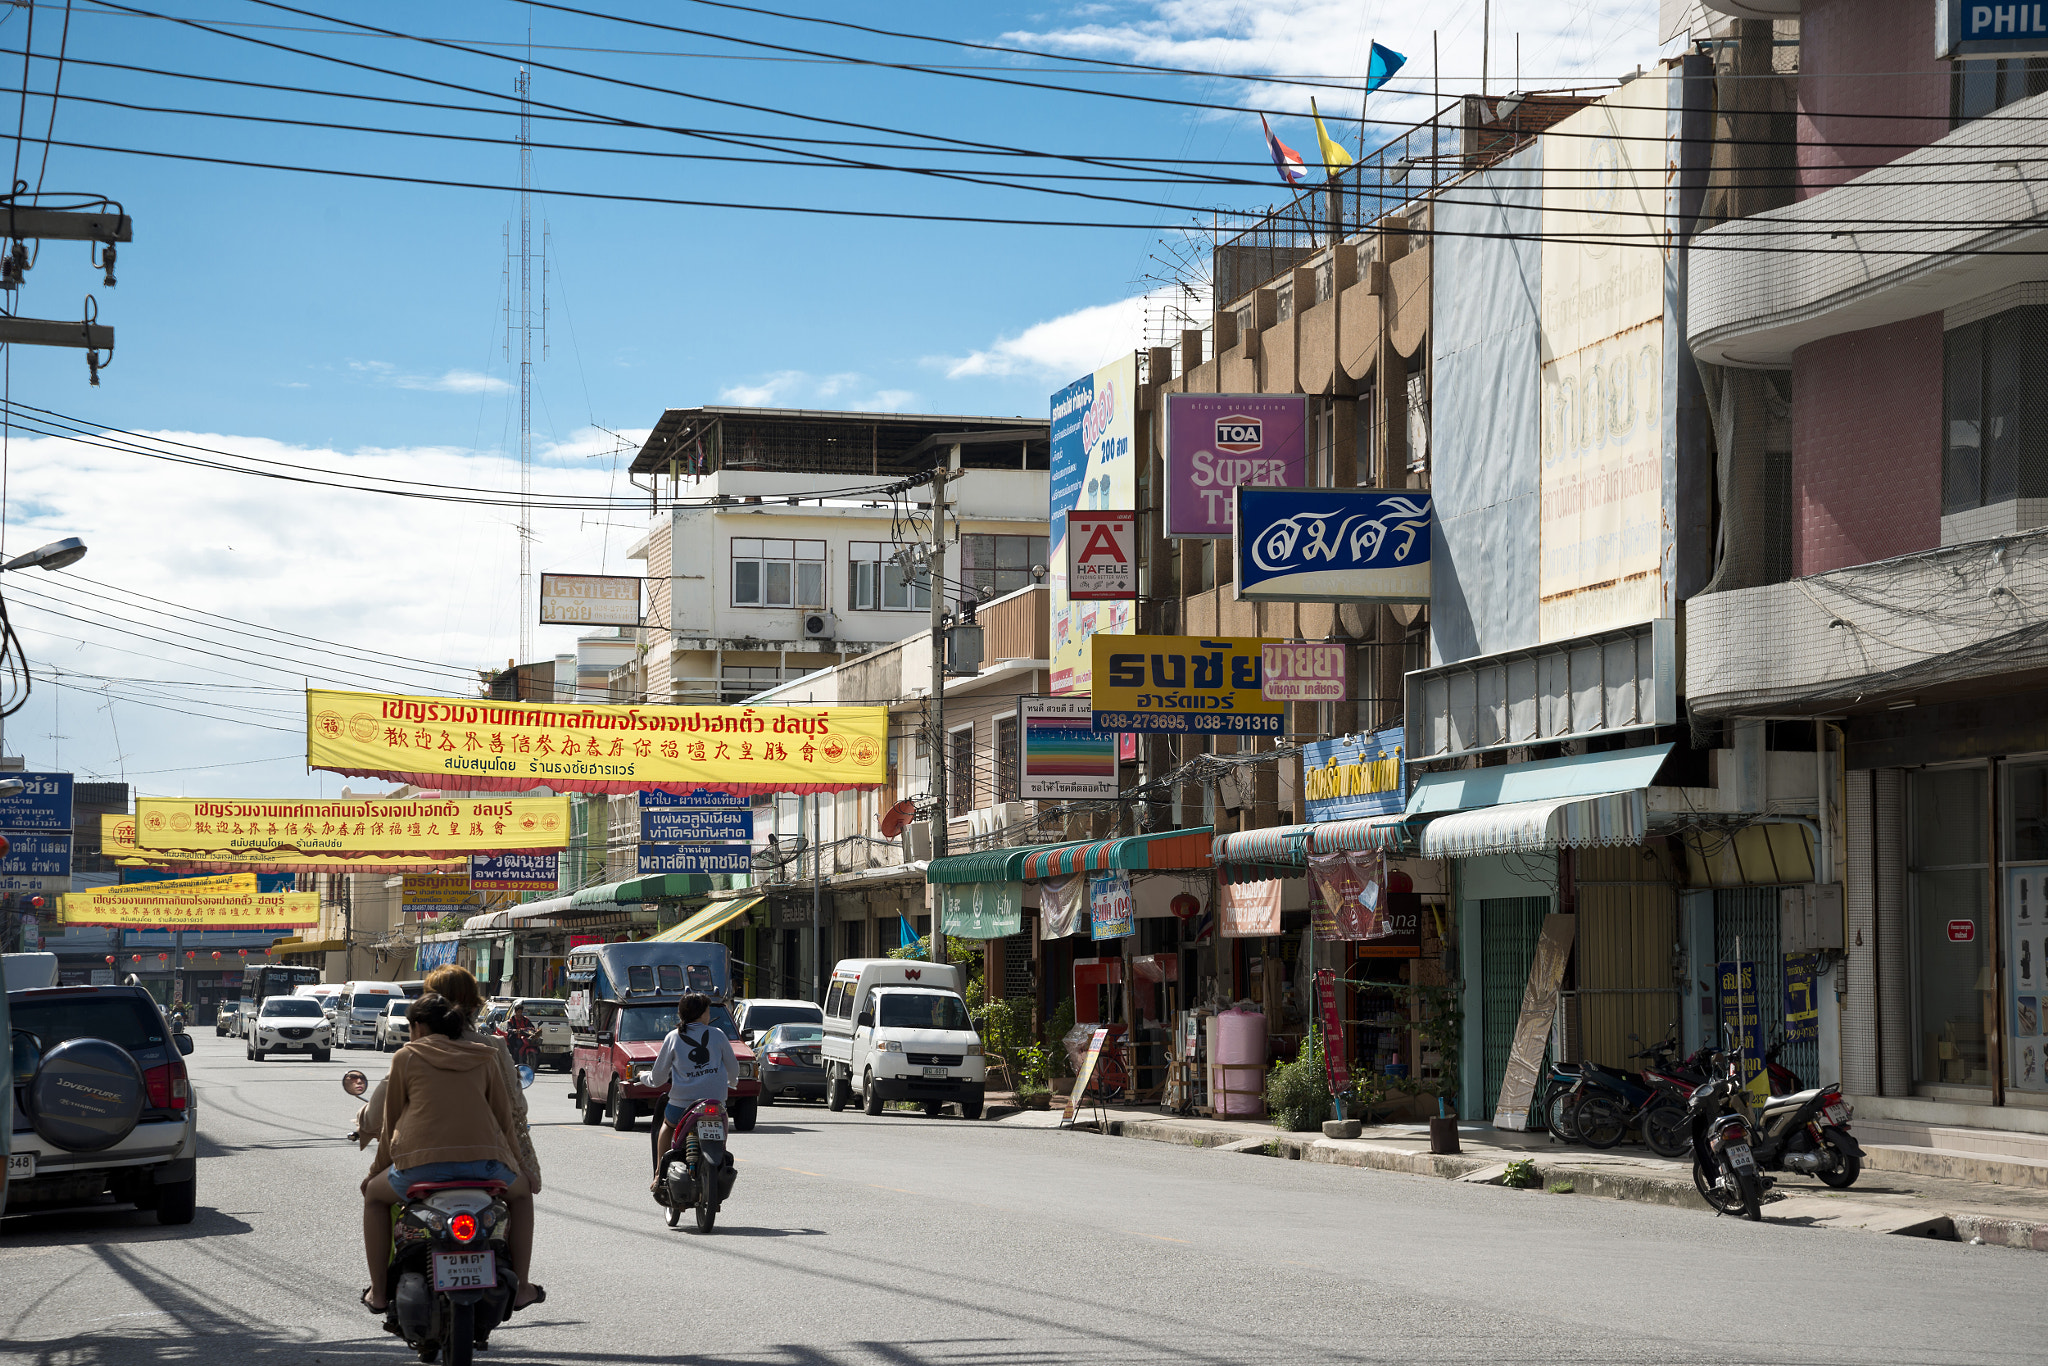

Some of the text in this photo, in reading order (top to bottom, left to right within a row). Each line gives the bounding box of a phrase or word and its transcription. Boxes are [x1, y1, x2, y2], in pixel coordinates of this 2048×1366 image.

[1971, 4, 2047, 34] PHIL
[1218, 426, 1259, 442] TOA
[1101, 437, 1115, 464] 200
[1190, 450, 1287, 487] SUPER
[1077, 564, 1129, 575] HÄFELE
[1109, 639, 1262, 690] ธงชัย
[1264, 647, 1345, 678] ขายยา
[1304, 681, 1340, 695] เภสัชกร
[1137, 690, 1235, 710] ฮาร์ดแวร์
[323, 718, 338, 733] 福
[382, 699, 829, 740] เชญรวมงานเทศกาลกินเจโรงเจเปาฮกตั้ว ชลบุรี
[1100, 711, 1190, 732] 038-273695,
[1194, 713, 1279, 731] 038-791316
[444, 754, 516, 774] สนับสนุนโดย
[680, 793, 745, 805] ผาหนังเทียม
[473, 800, 513, 820] ชลบุรี
[653, 812, 742, 829] แผ่นอลูมิเนียม
[649, 826, 746, 838] ทำโครงกันสาด
[678, 846, 711, 854] จำหน่าย
[495, 855, 556, 869] วฒนชย
[639, 853, 750, 874] พลาสติก ทุกชนิด
[404, 874, 471, 889] เจริญค้าข้า
[257, 894, 285, 908] ชลบุรี
[686, 1067, 719, 1078] PLAYBOY
[450, 1275, 481, 1287] 705
